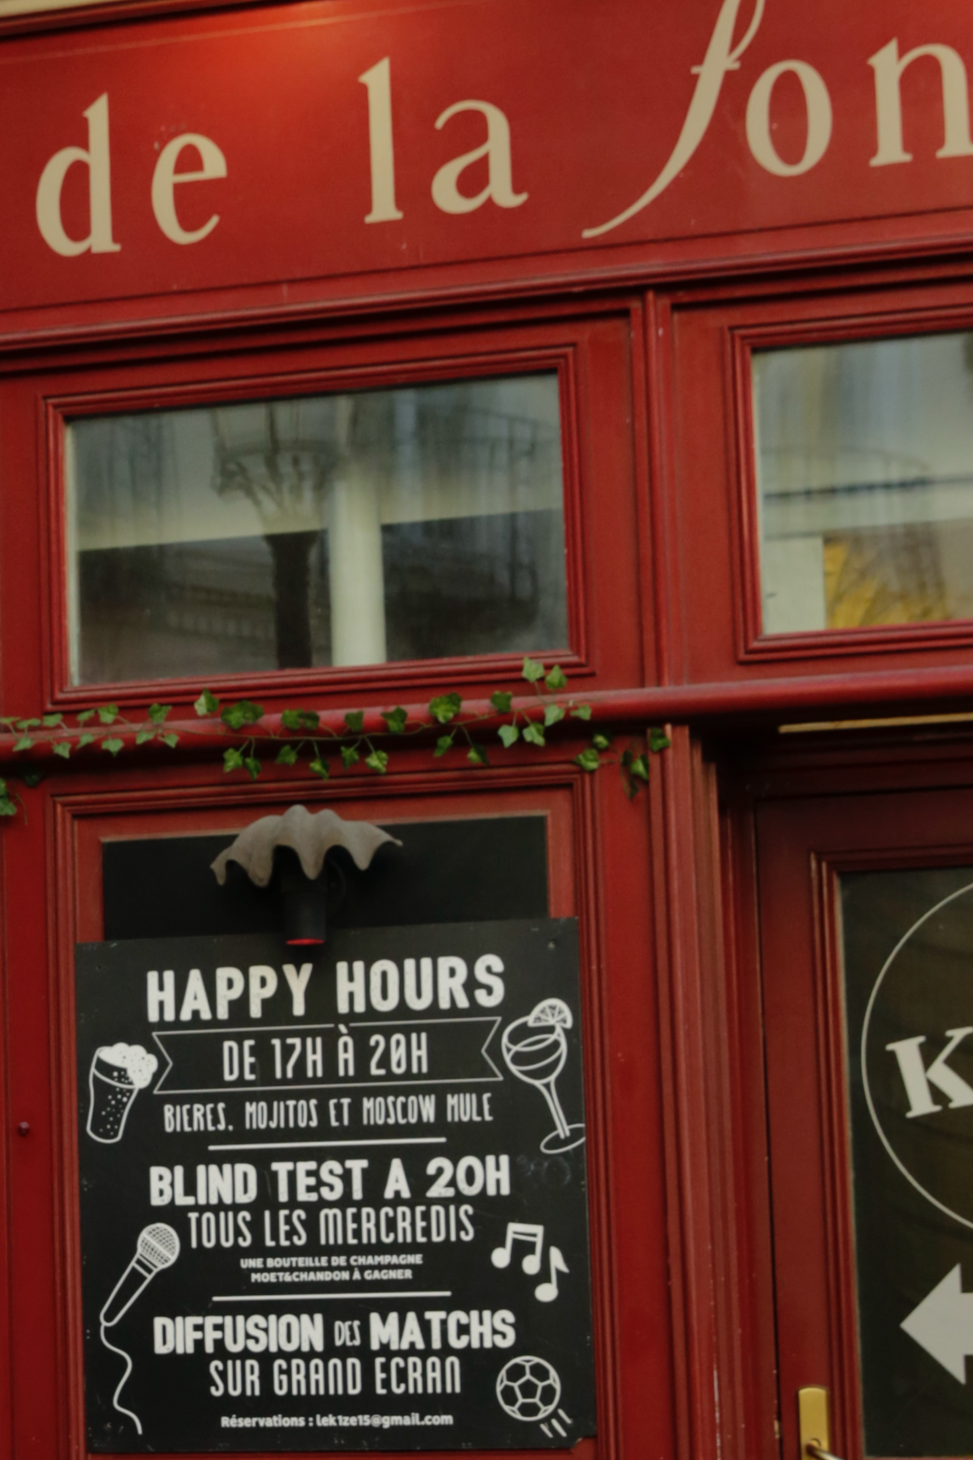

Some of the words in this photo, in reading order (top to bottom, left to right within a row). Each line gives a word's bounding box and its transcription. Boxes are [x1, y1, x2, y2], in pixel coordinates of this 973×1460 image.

[35, 92, 228, 257] de
[358, 56, 529, 224] la
[146, 962, 314, 1023] HAPPY
[335, 953, 506, 1014] HOURS
[222, 1039, 257, 1082] DE
[270, 1036, 323, 1080] 17H
[337, 1023, 355, 1077] À
[369, 1031, 428, 1076] 20H
[245, 1098, 319, 1130] MOJITOS
[328, 1097, 352, 1127] ET
[362, 1094, 436, 1126] MOSCOW
[446, 1092, 494, 1123] MULE
[149, 1162, 258, 1206] BLIND
[270, 1158, 369, 1203] TEST
[383, 1157, 412, 1200] A
[425, 1154, 511, 1198] 20H
[187, 1209, 252, 1249] TOUS
[263, 1208, 307, 1248] LES
[318, 1203, 475, 1246] MERCREDIS
[240, 1257, 264, 1269] UNE
[266, 1256, 329, 1269] BOUTEILLE
[331, 1255, 347, 1267] DE
[349, 1253, 423, 1266] CHAMPAGNE
[250, 1270, 350, 1283] MOET&CHANDON
[363, 1268, 413, 1281] GAGNER
[153, 1313, 324, 1355] DIFFUSION
[334, 1319, 361, 1347] DES
[369, 1309, 517, 1351] MATCHS
[209, 1359, 260, 1397] SUR
[273, 1357, 362, 1396] GRAND
[374, 1355, 461, 1395] ECRAN
[220, 1414, 306, 1428] Réservations
